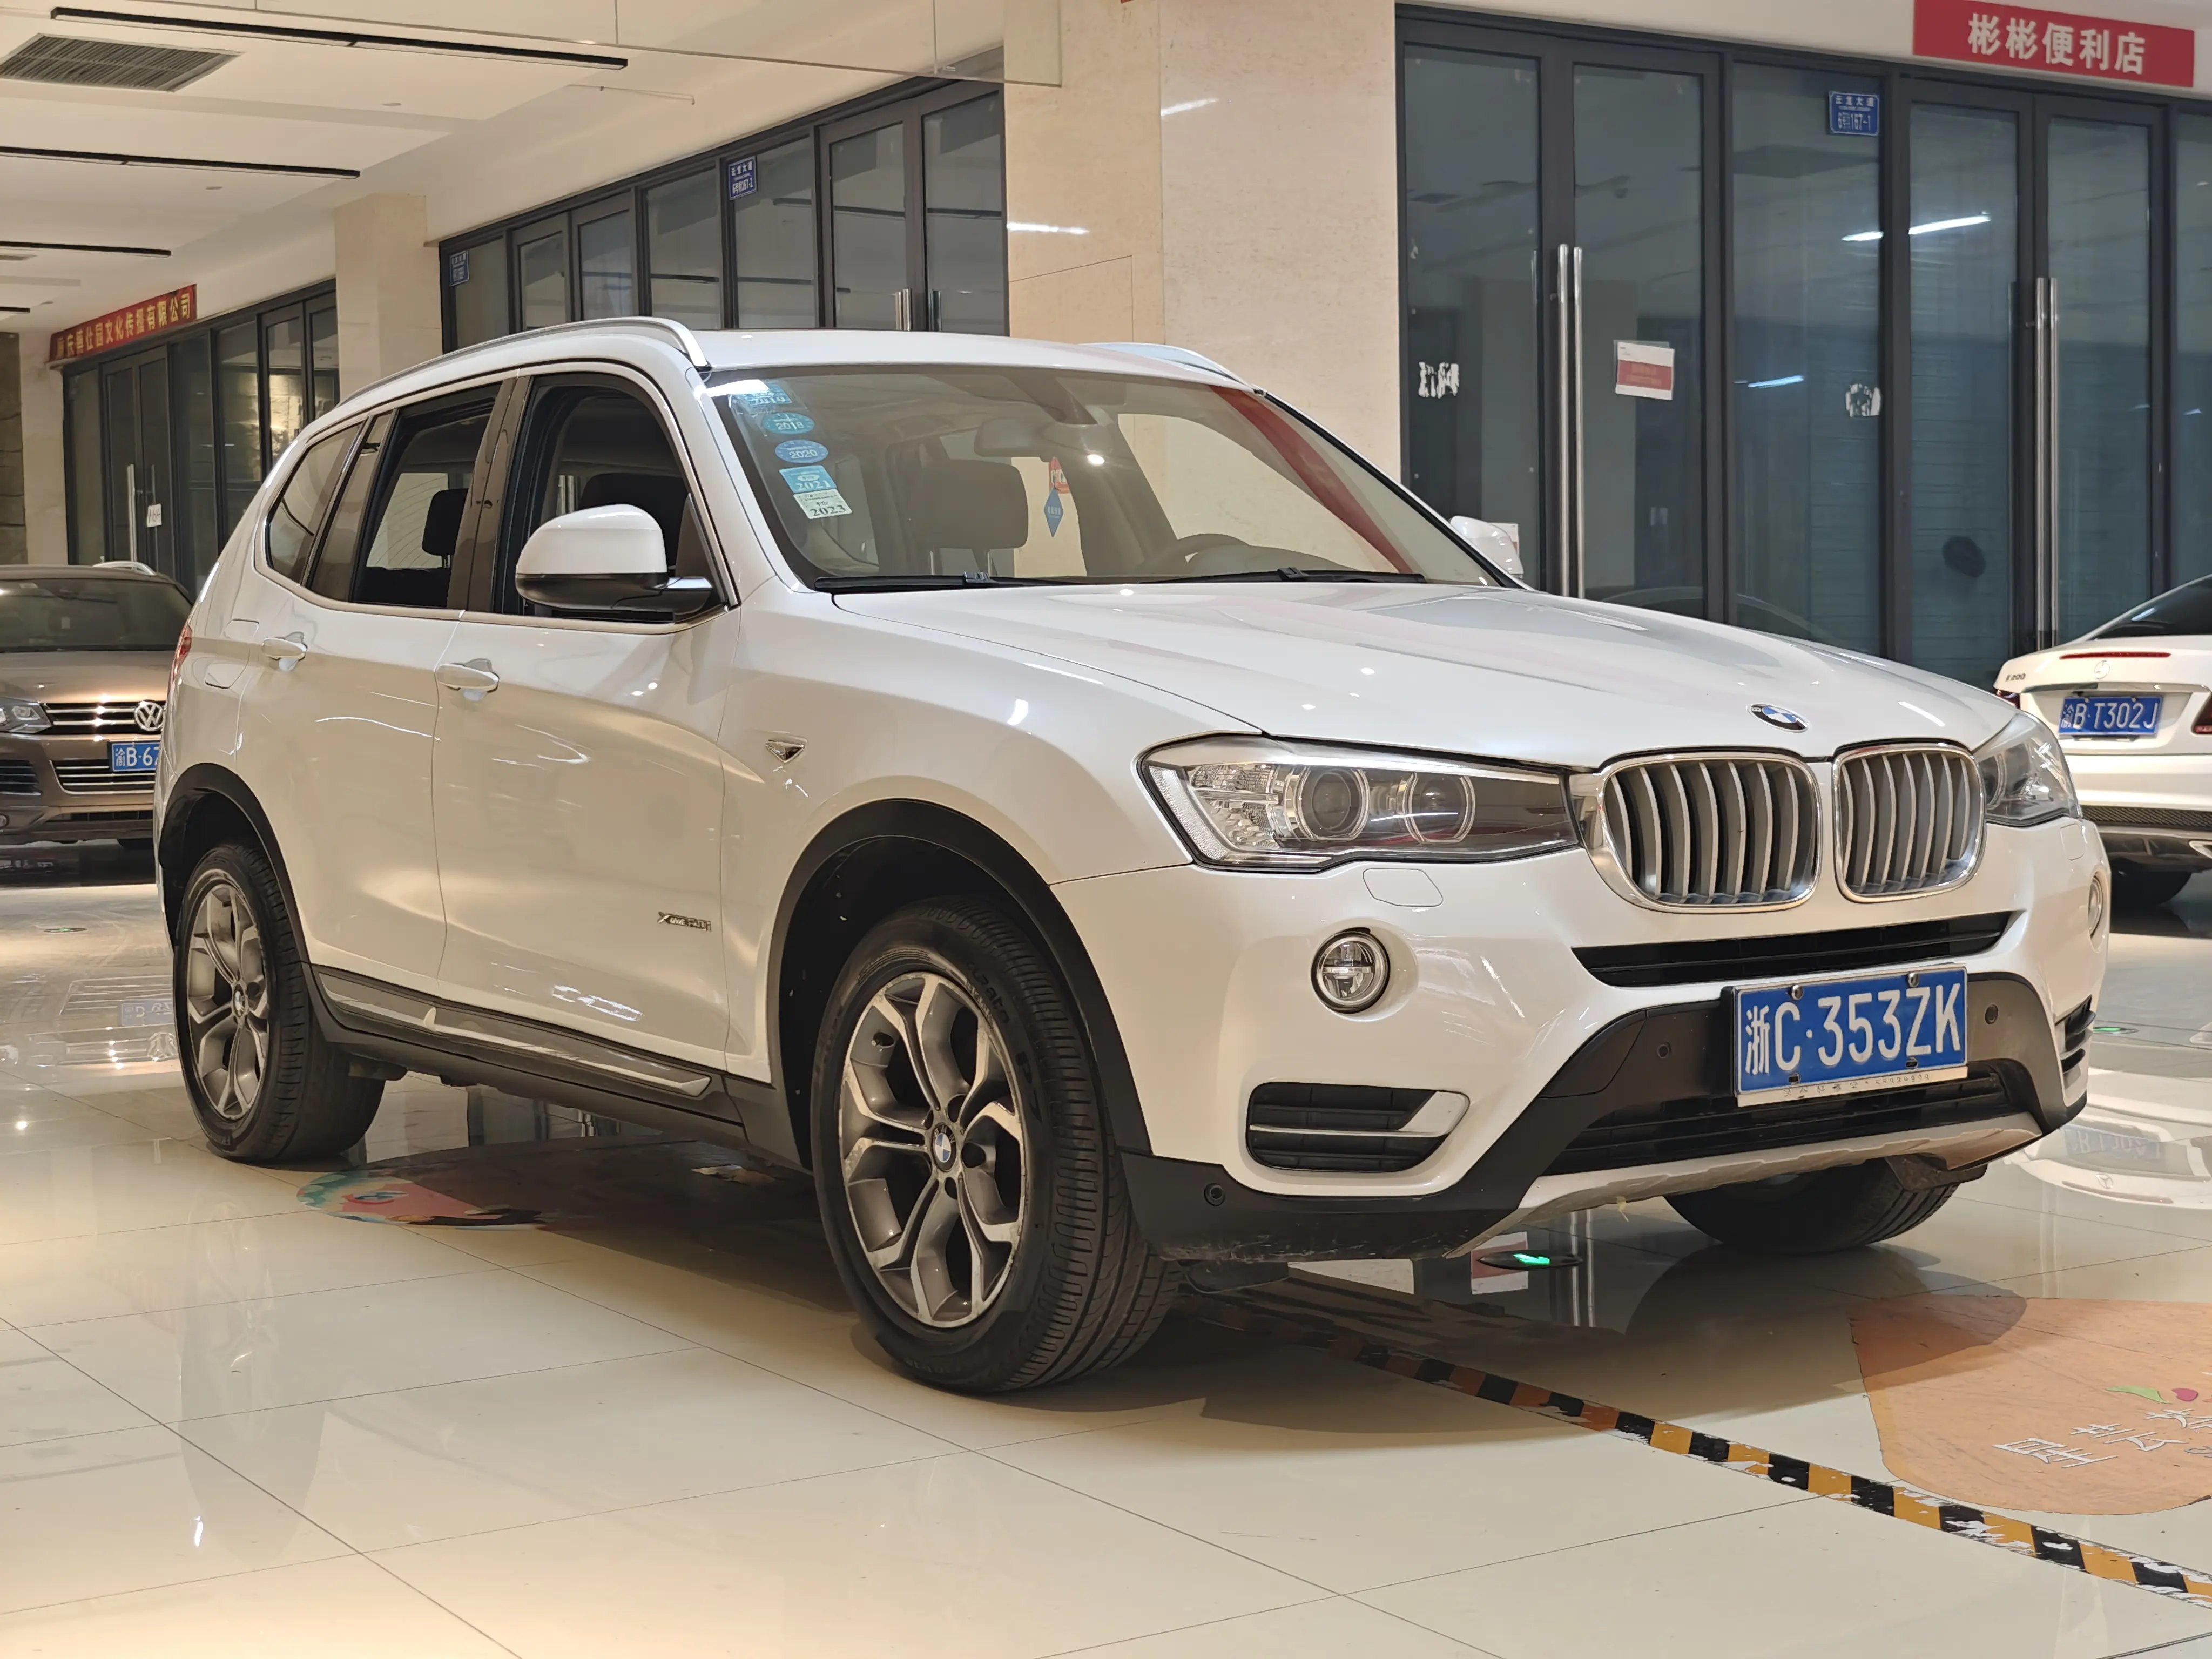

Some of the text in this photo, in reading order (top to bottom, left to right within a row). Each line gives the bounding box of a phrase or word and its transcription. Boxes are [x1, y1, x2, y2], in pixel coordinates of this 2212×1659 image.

[1967, 12, 2146, 75] 彬彬便利店
[775, 421, 804, 431] 2018
[788, 449, 818, 459] 2020
[795, 480, 832, 491] 2021
[810, 504, 846, 517] 2023
[1745, 983, 1962, 1076] 浙C·353ZK
